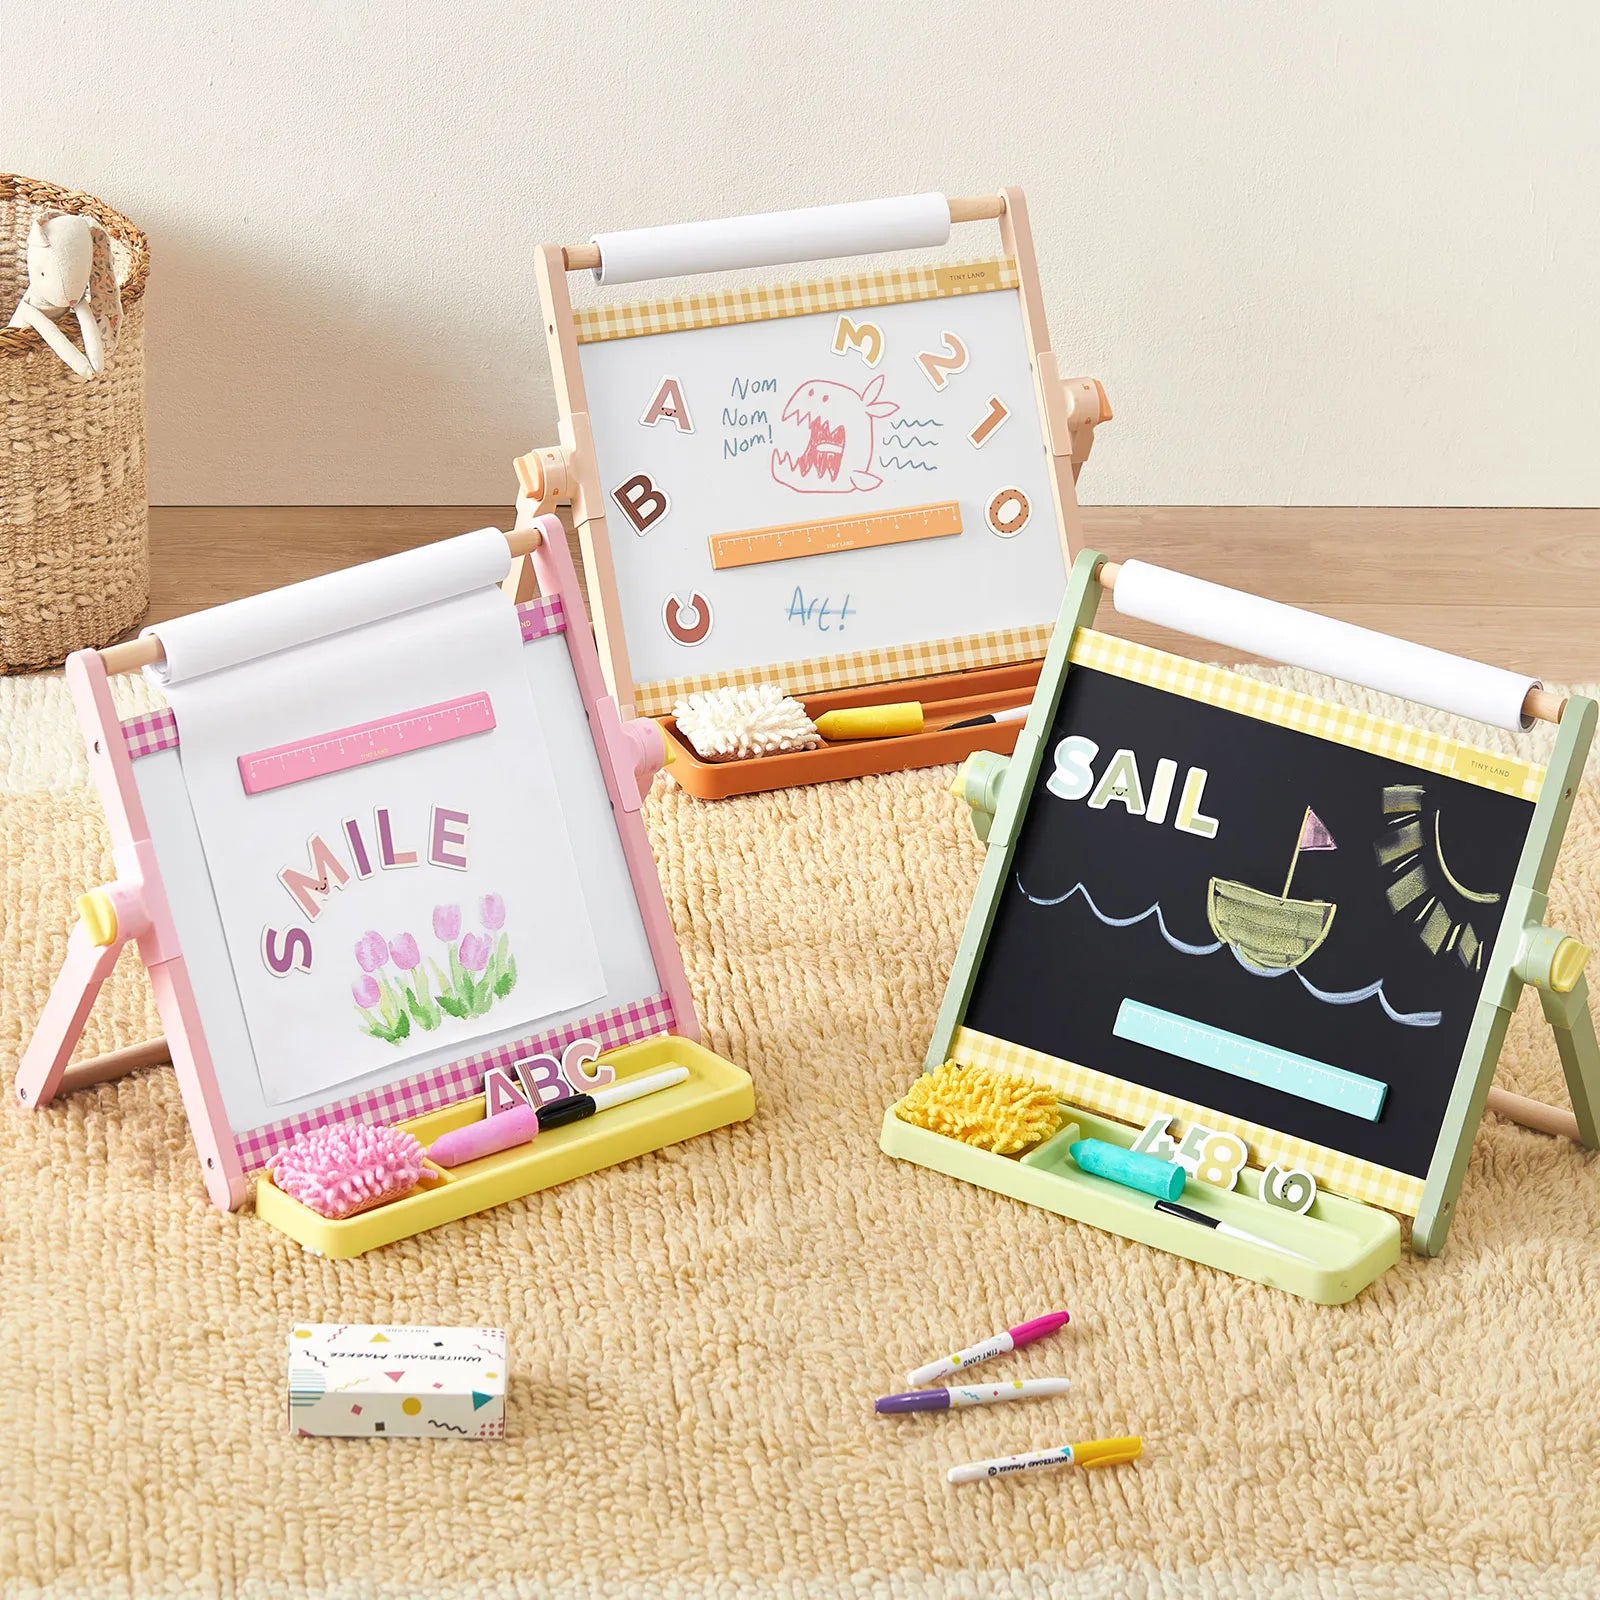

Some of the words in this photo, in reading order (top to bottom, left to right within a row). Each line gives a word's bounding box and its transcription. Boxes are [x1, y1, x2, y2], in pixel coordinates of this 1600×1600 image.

[967, 271, 985, 279] LAND
[731, 377, 777, 400] Nom
[834, 316, 883, 368] 3
[918, 332, 970, 388] 2
[969, 395, 1010, 446] 1
[641, 376, 693, 434] A
[722, 407, 768, 426] Nom
[724, 424, 773, 460] Nom!
[612, 474, 669, 535] B
[521, 620, 532, 628] ND
[786, 585, 850, 632] Art!
[1470, 760, 1488, 771] TINY
[1489, 766, 1510, 778] LAND
[1047, 737, 1218, 838] SAIL
[265, 806, 470, 974] SMILE
[488, 1041, 614, 1117] ABC
[963, 1355, 981, 1367] LAND
[982, 1348, 998, 1360] TINY
